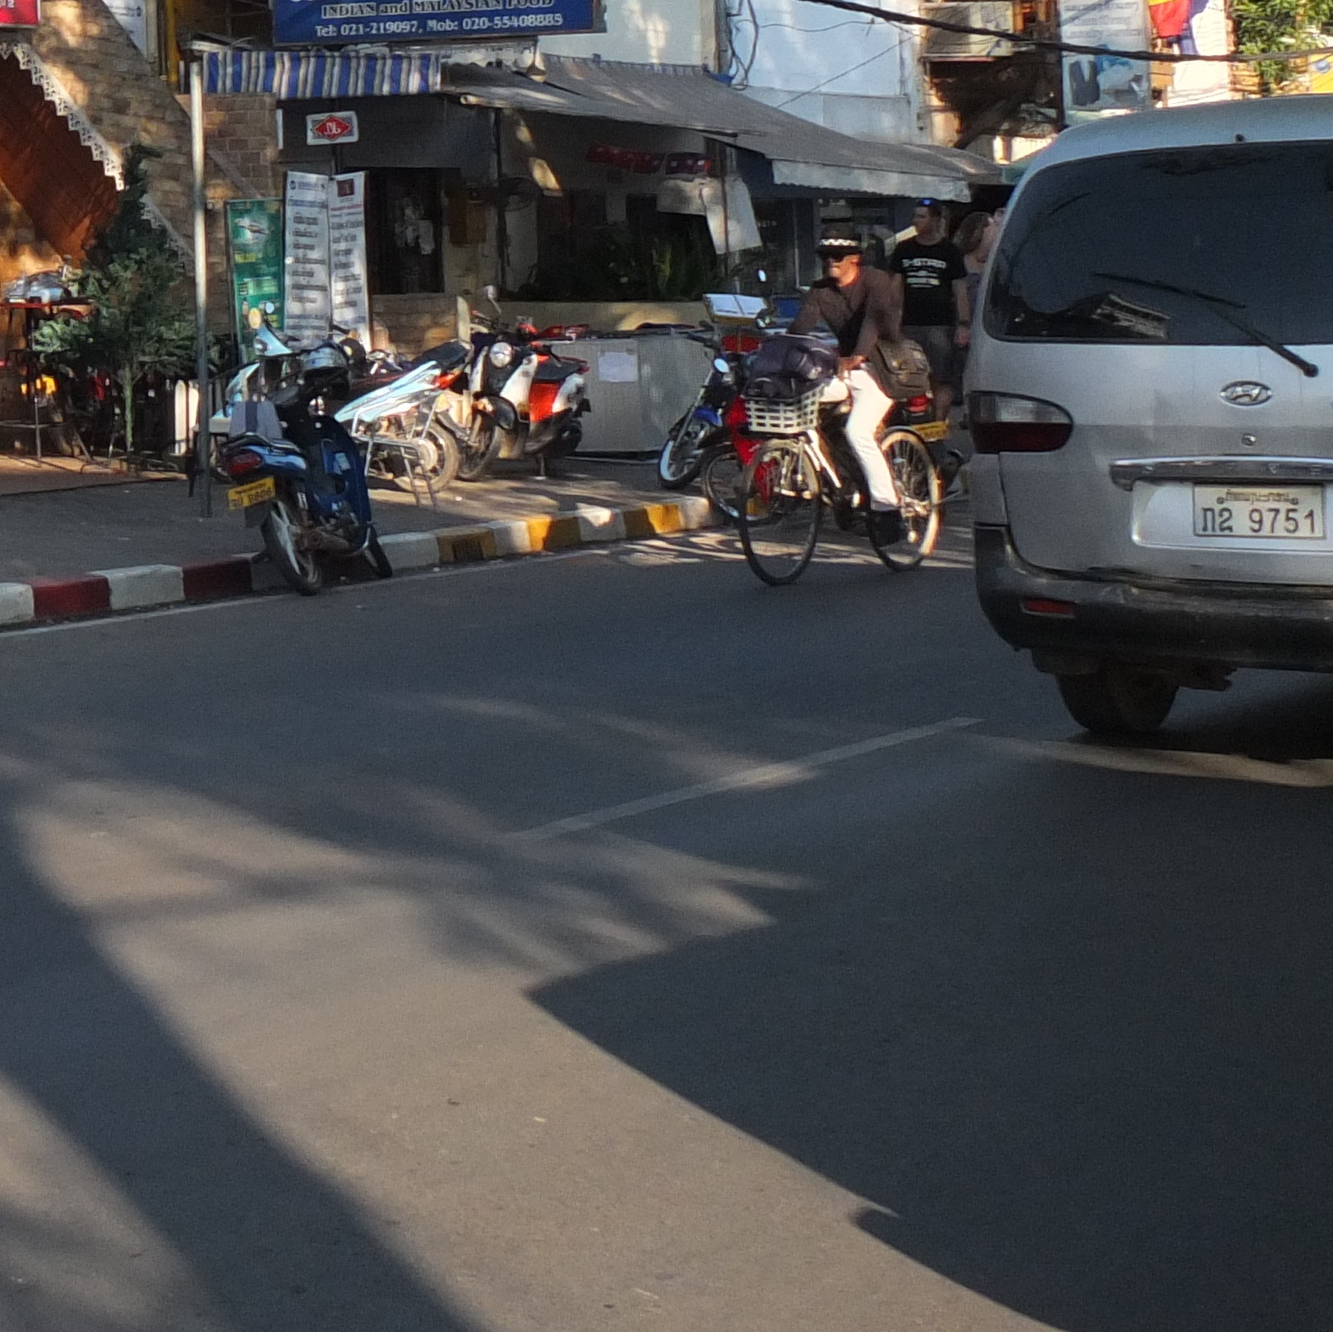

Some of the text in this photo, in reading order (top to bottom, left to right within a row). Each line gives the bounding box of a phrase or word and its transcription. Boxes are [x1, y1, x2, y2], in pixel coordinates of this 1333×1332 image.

[322, 2, 375, 18] INDIAN
[380, 0, 408, 15] and
[315, 24, 337, 38] Tel:
[426, 18, 458, 33] Mob:
[1248, 507, 1316, 534] 9751
